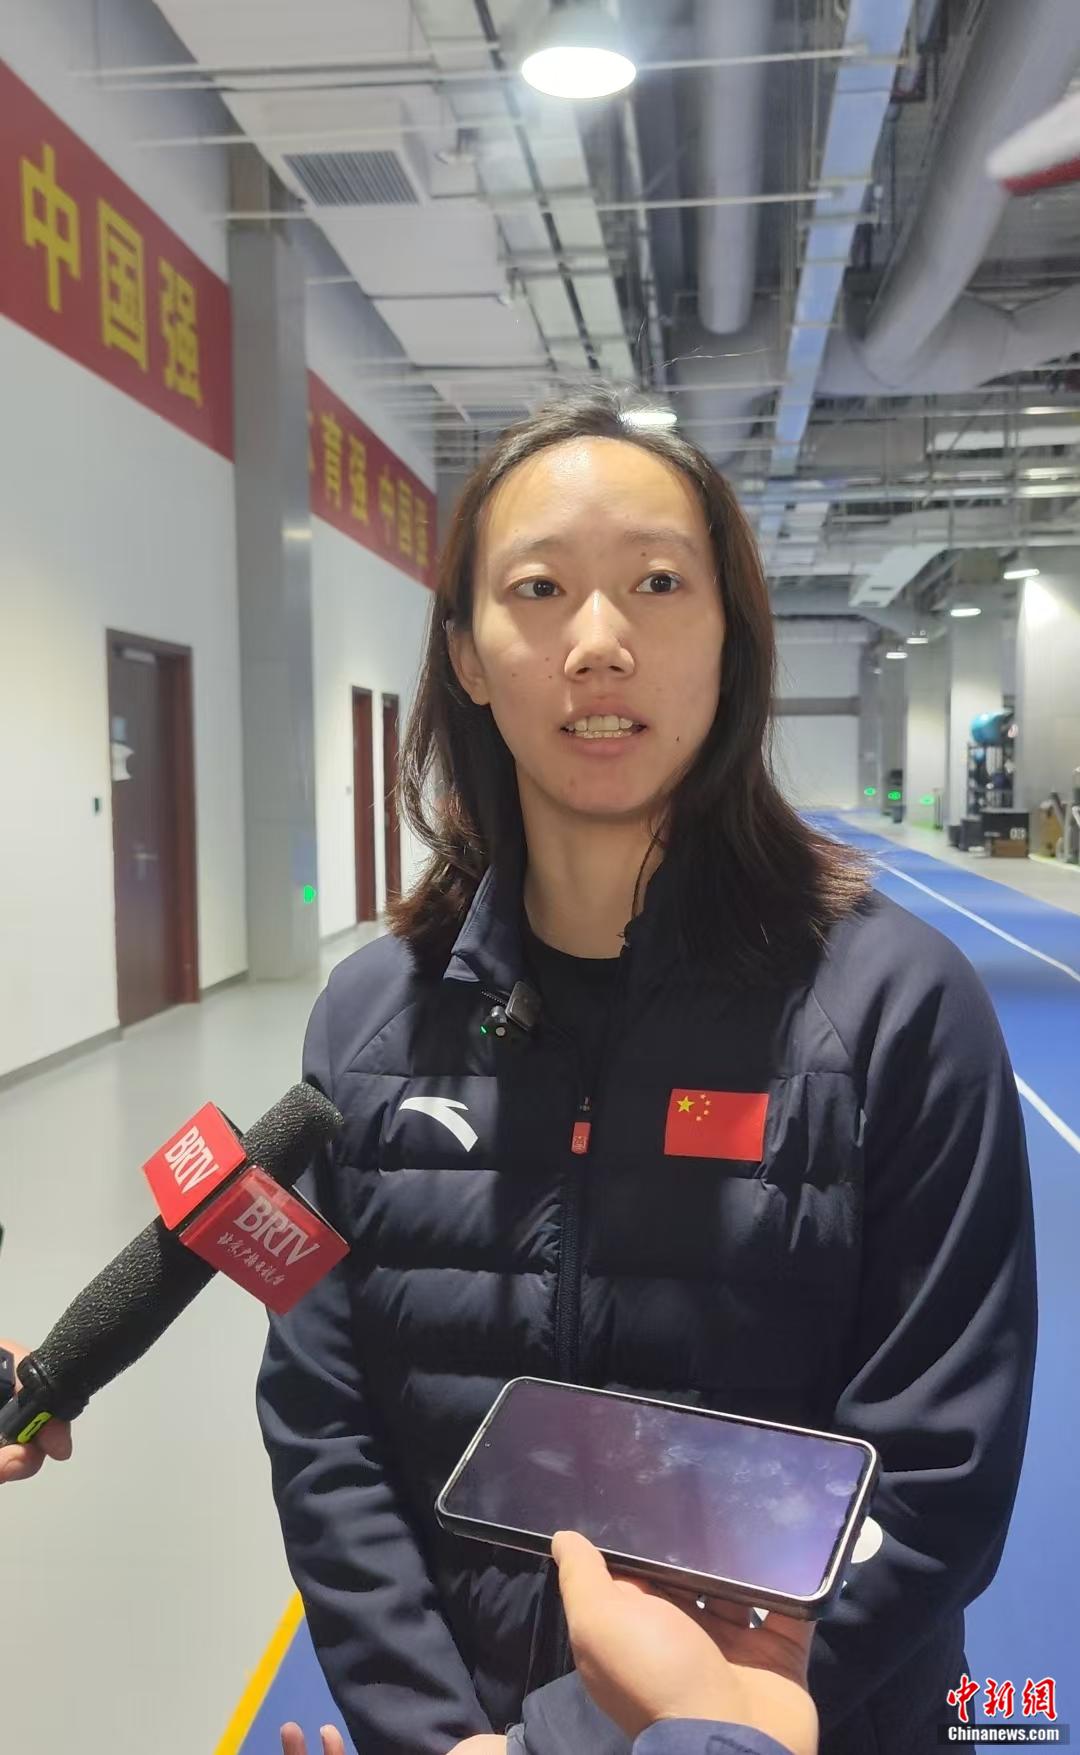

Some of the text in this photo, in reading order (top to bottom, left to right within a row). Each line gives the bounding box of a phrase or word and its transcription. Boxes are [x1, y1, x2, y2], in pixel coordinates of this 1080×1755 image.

[20, 142, 202, 408] 中国强
[307, 409, 368, 525] 育强
[164, 1125, 220, 1194] BRTV
[233, 1196, 320, 1266] BRTV
